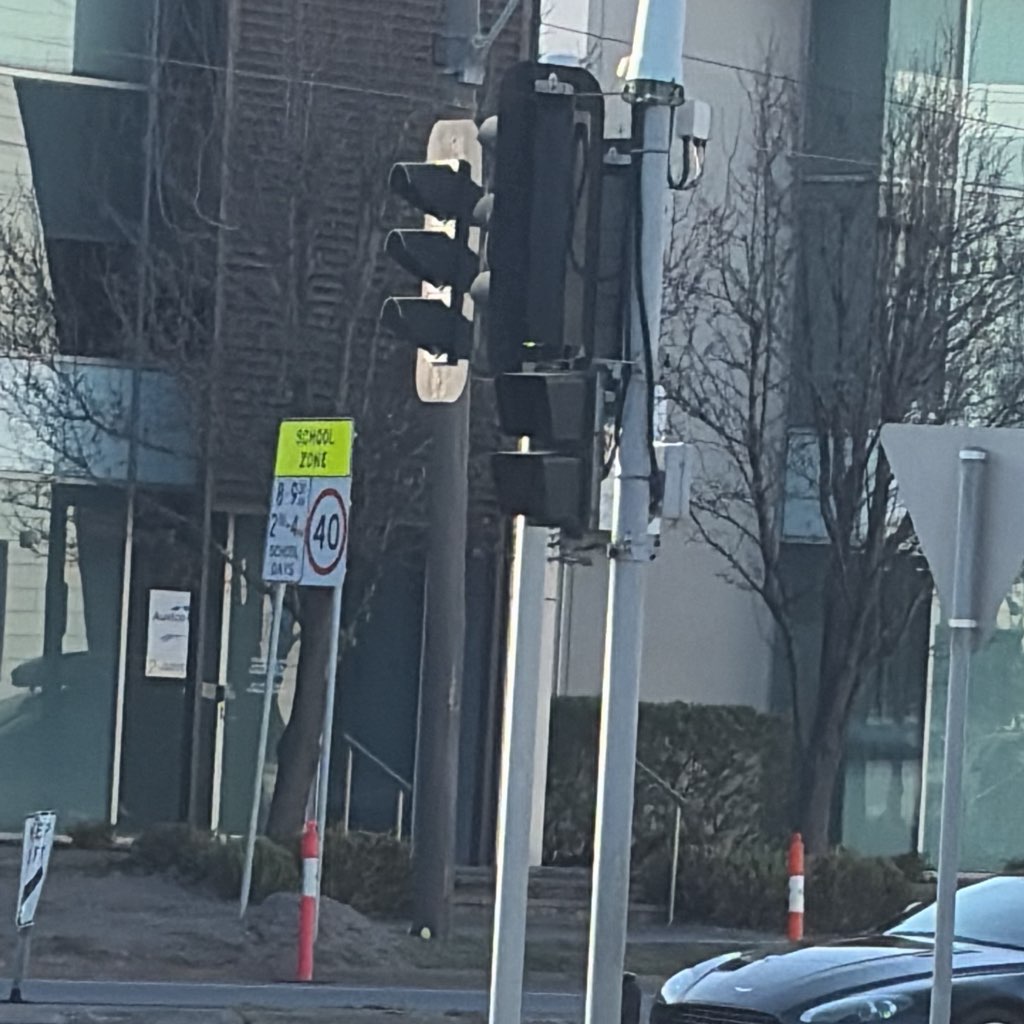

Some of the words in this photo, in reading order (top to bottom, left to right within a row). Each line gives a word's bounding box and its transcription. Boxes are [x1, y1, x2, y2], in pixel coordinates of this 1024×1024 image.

[296, 429, 335, 445] SCHOOL
[299, 451, 328, 468] ZONE
[313, 513, 340, 551] 40
[271, 562, 295, 576] DAYS
